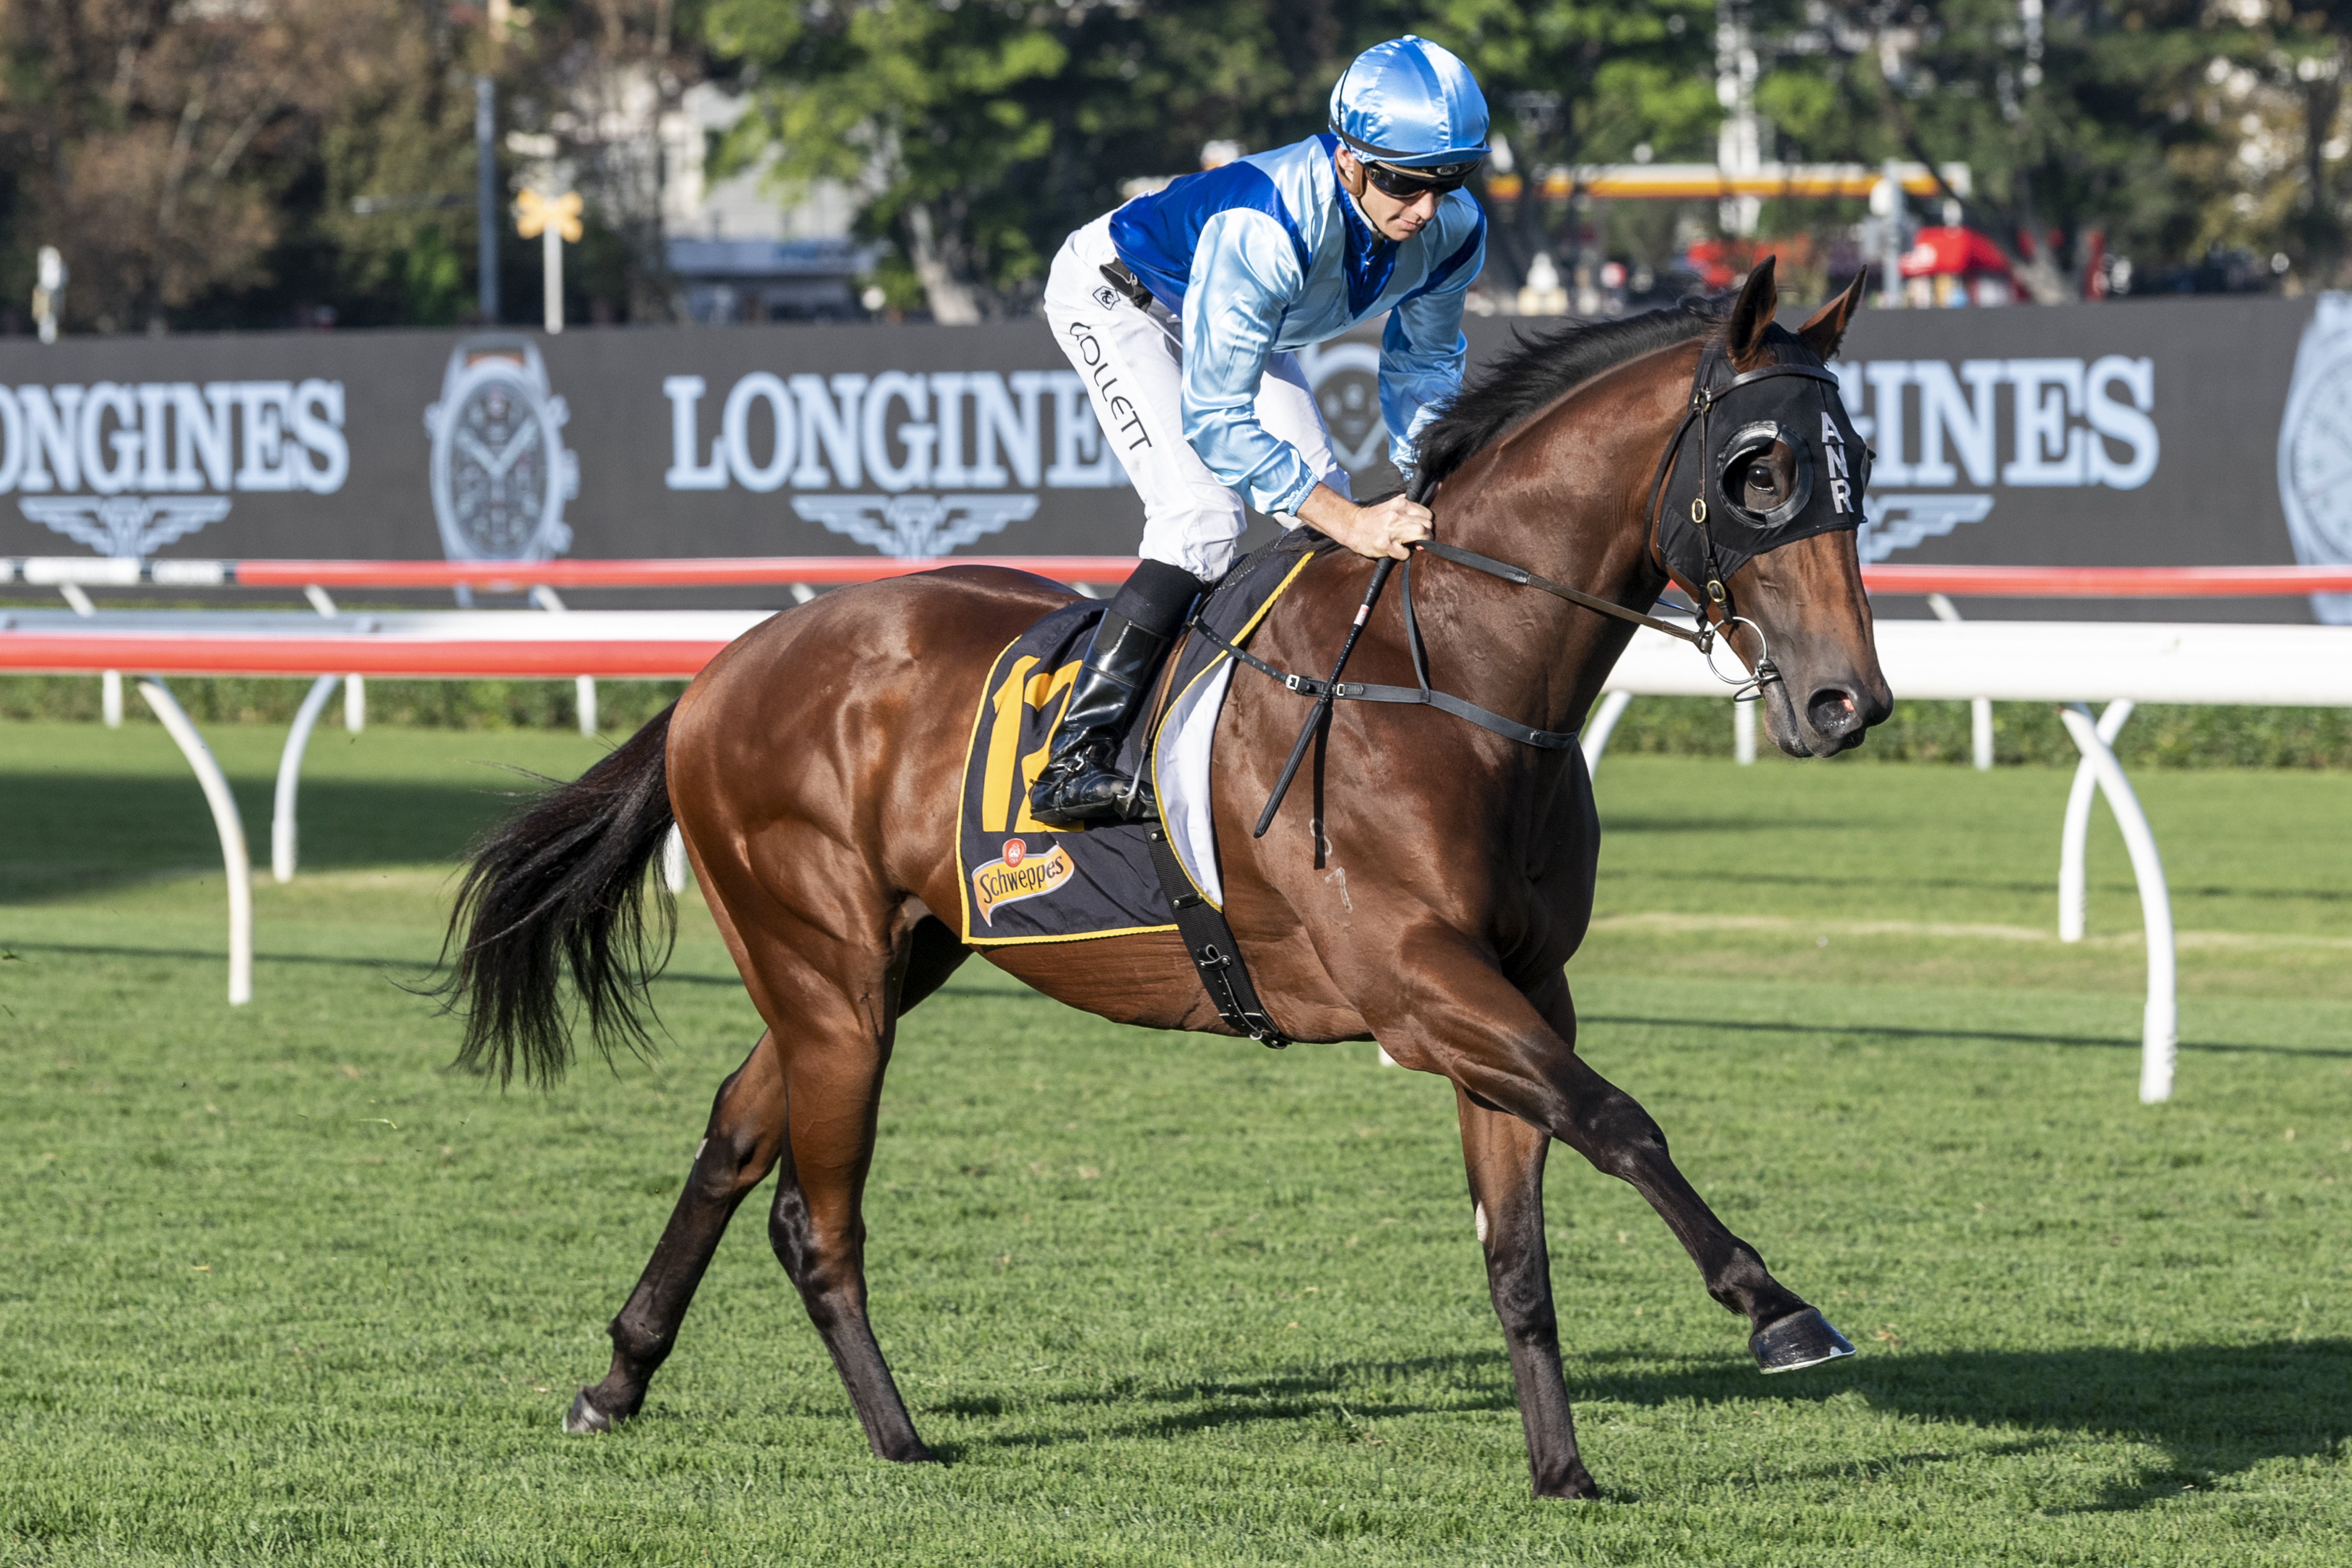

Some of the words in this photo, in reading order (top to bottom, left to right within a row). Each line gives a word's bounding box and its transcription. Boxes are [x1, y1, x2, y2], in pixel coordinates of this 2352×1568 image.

[663, 370, 1133, 492] LONGINE
[1070, 322, 1152, 451] COLLETT
[1821, 411, 1854, 513] ANR
[979, 856, 1064, 904] Schweppes
